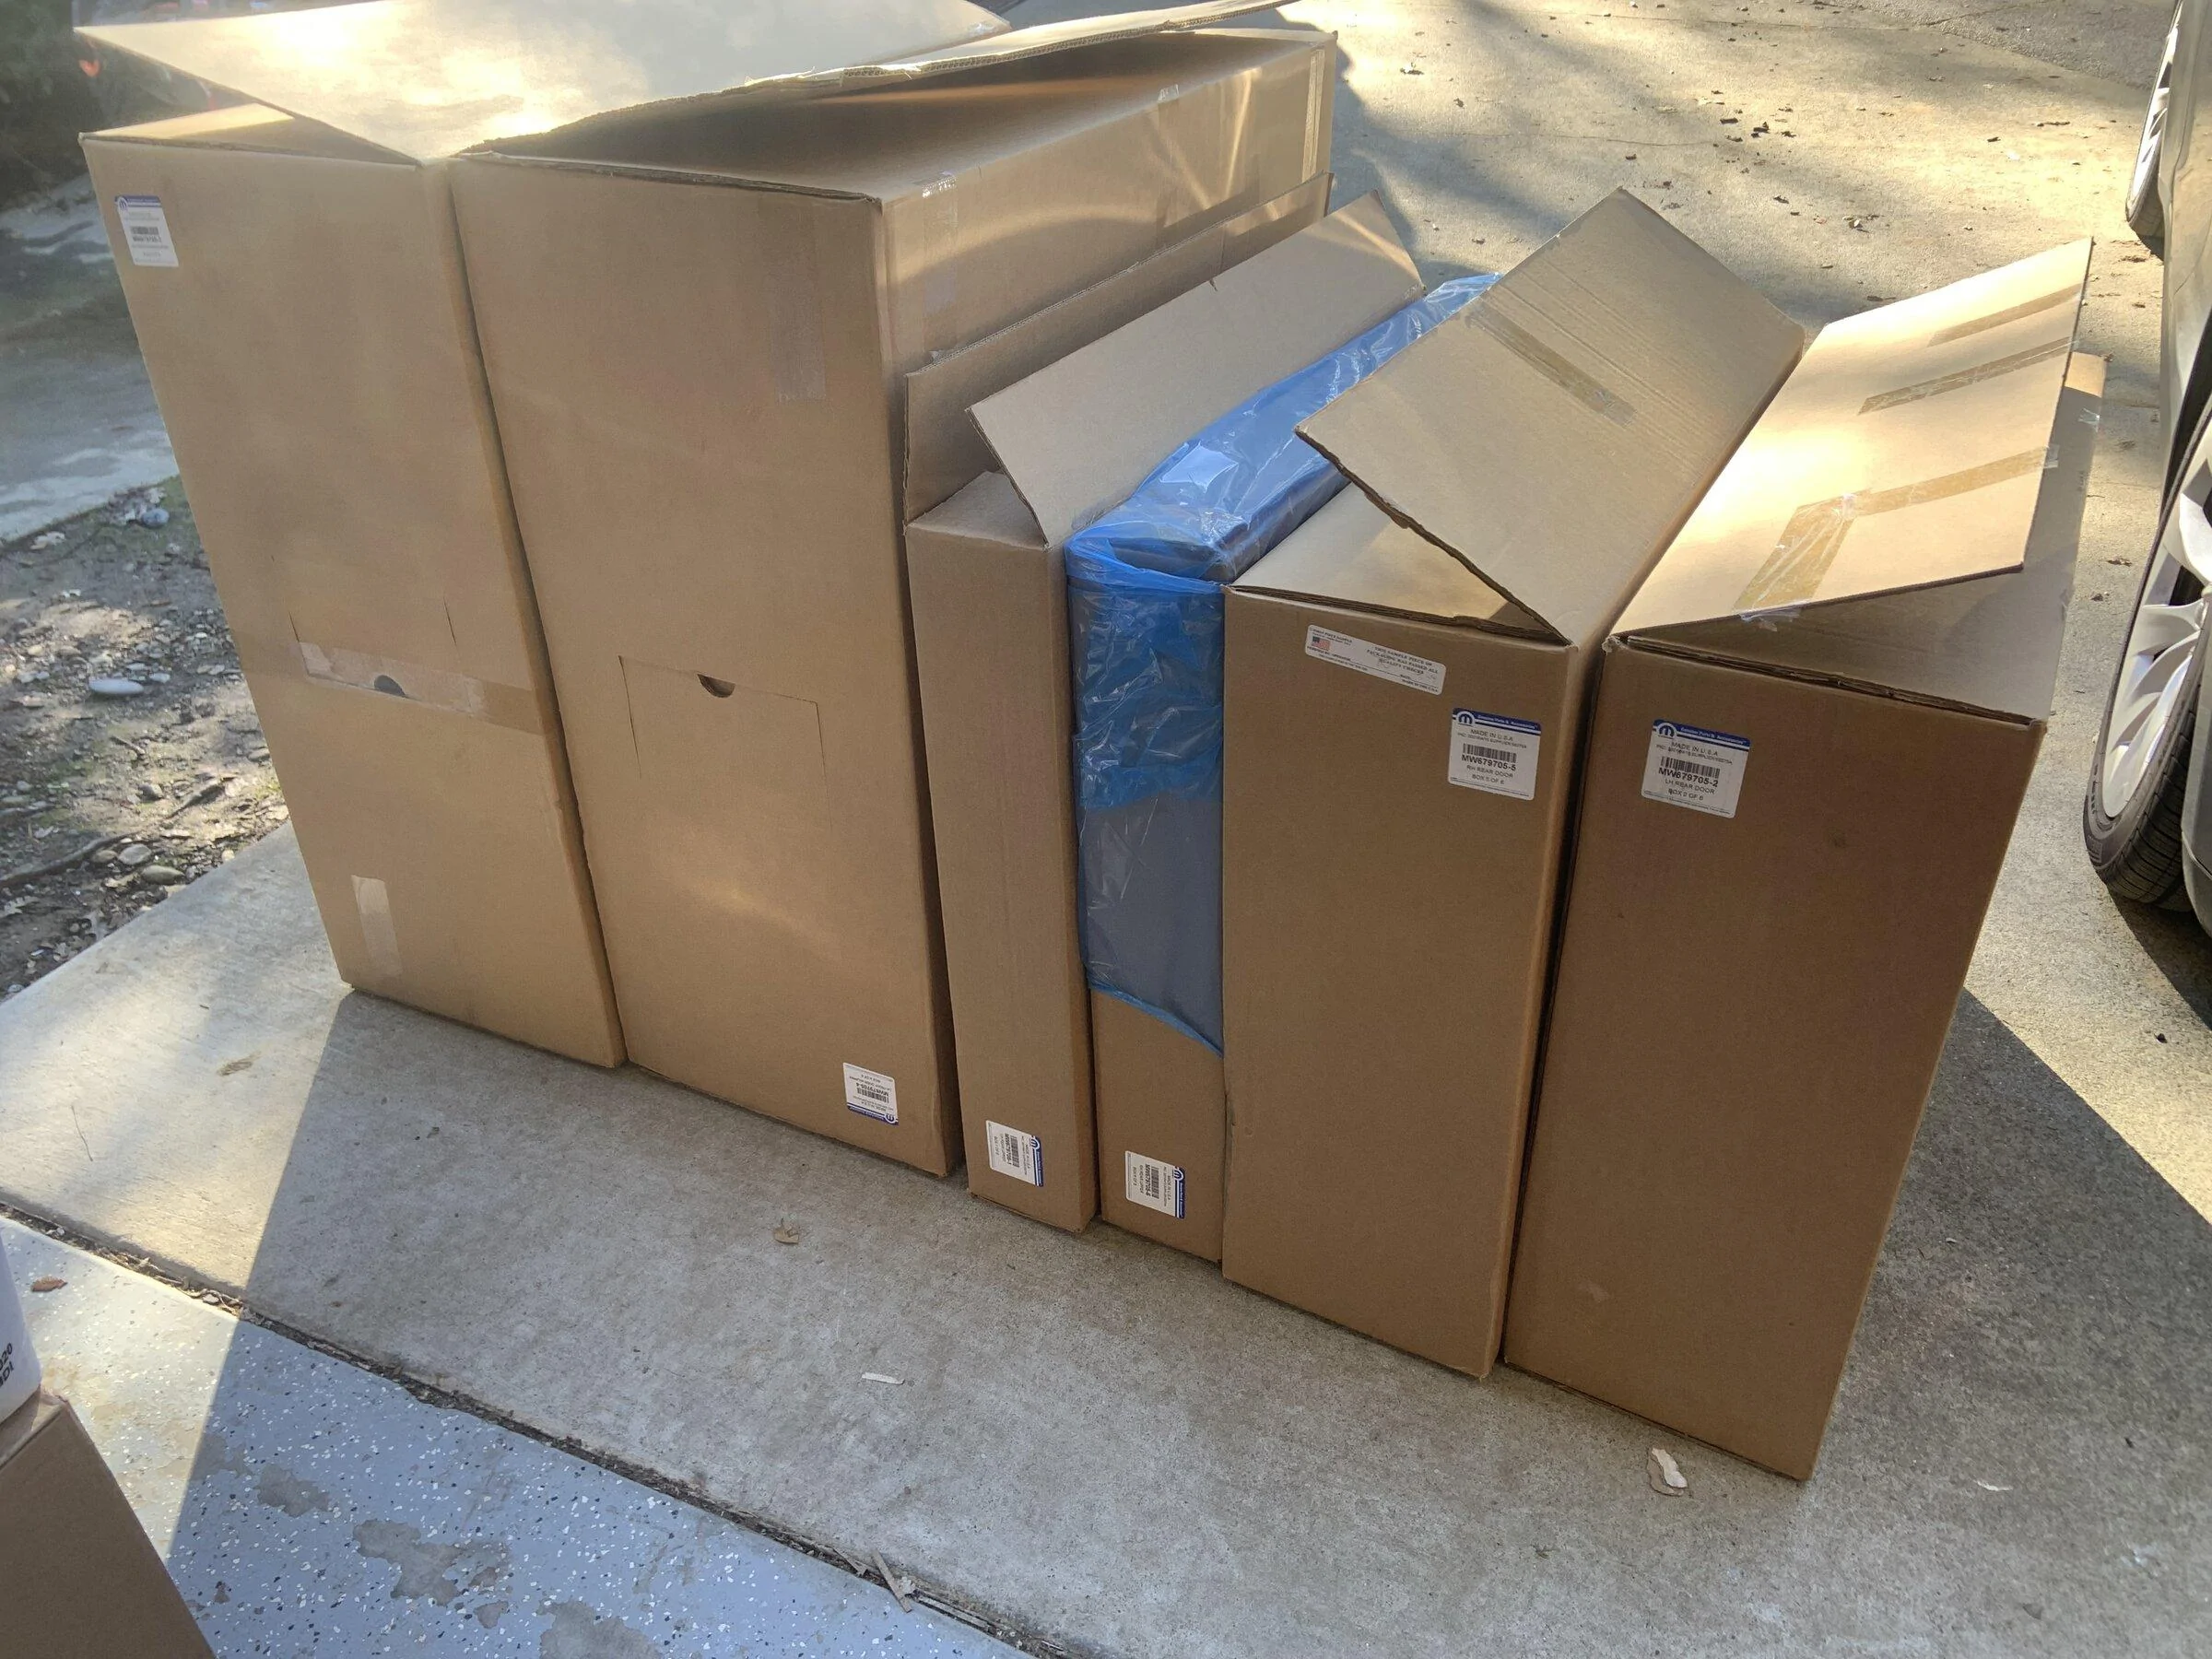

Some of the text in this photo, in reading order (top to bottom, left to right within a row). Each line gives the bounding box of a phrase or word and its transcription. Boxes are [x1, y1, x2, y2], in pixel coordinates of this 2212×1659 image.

[1470, 728, 1488, 736] MADE
[1670, 742, 1690, 750] MADE
[1461, 754, 1516, 771] MW679705-5
[1494, 770, 1512, 778] DOOR
[1658, 767, 1718, 787] MW679705-2
[1674, 781, 1693, 789] REAR
[1693, 784, 1715, 794] DOOR
